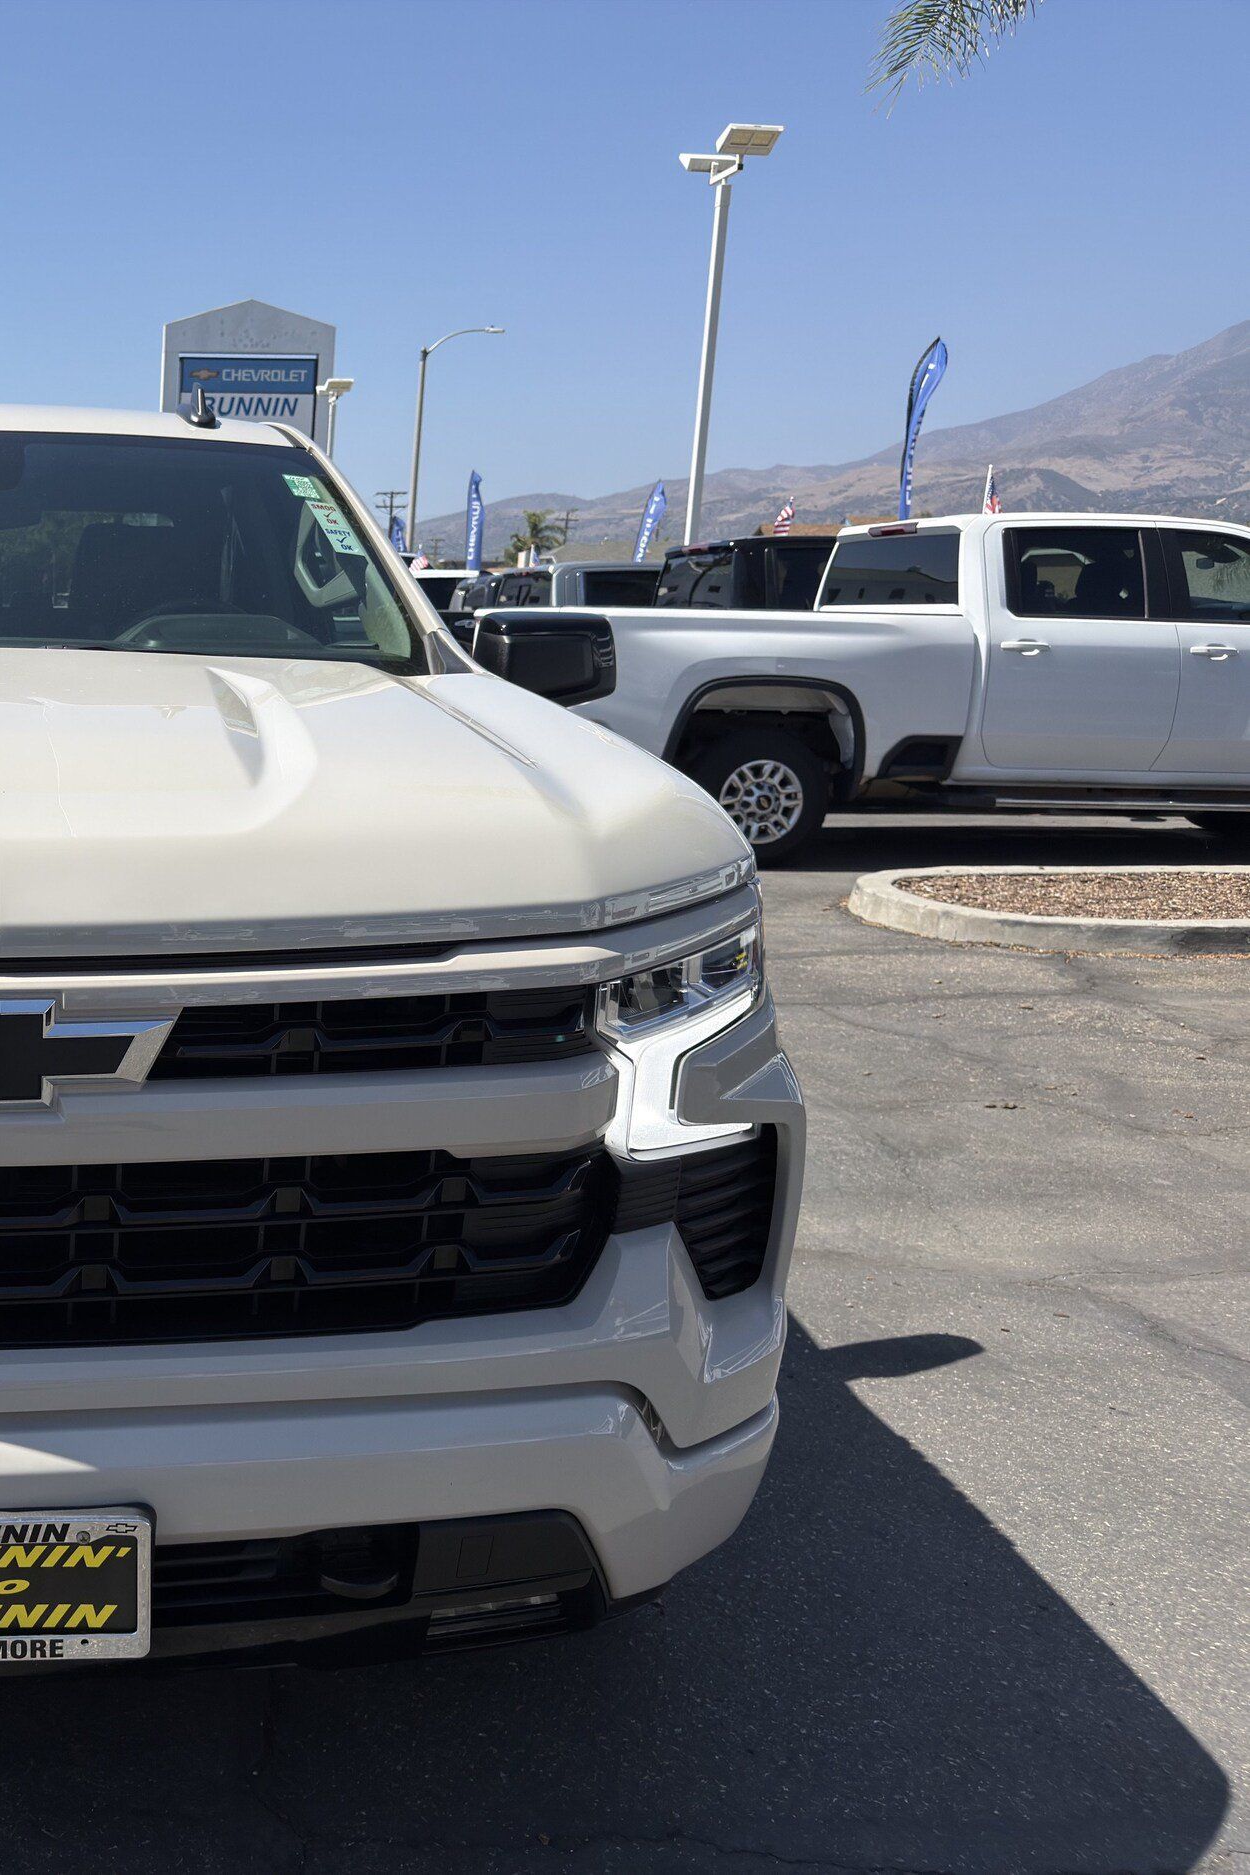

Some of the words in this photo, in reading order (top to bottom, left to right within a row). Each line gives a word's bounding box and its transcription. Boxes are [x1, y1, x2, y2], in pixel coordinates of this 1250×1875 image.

[222, 369, 307, 382] CHEVROLET
[311, 503, 336, 512] SMOG
[325, 528, 350, 538] SAFETY
